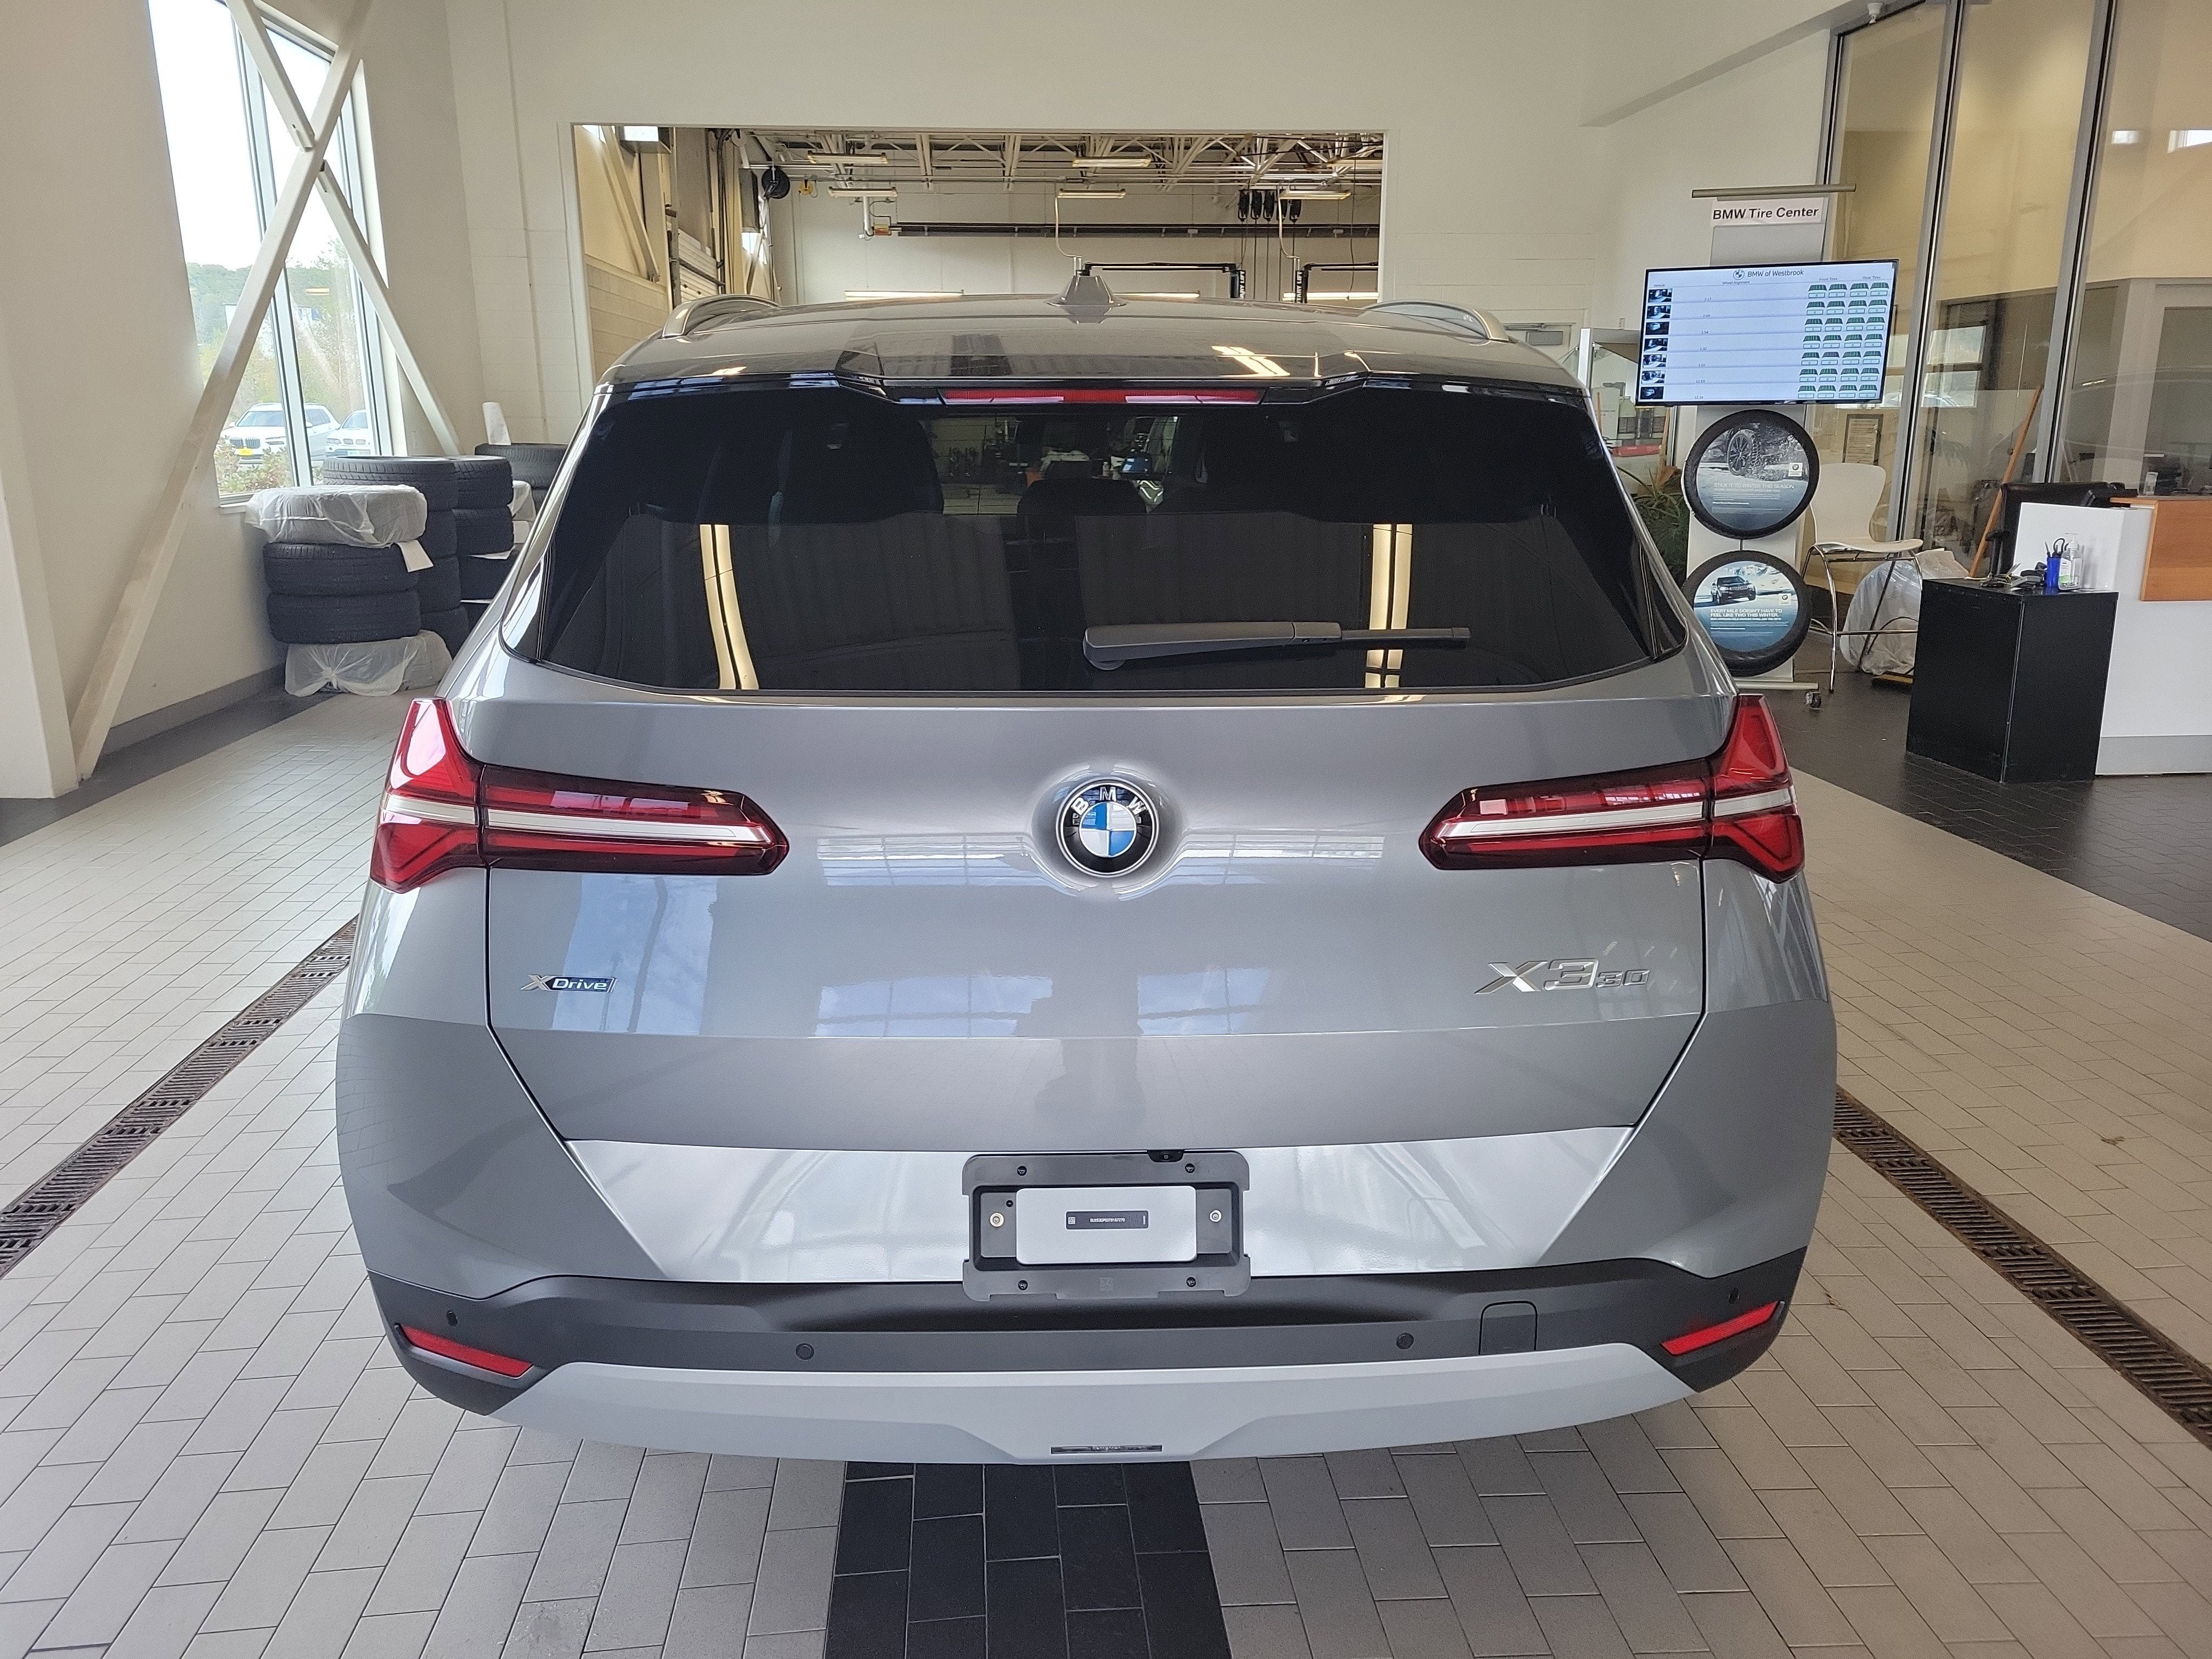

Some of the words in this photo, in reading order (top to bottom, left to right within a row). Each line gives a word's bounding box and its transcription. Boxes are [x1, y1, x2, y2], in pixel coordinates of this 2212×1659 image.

[1713, 208, 1746, 219] BMW
[1749, 208, 1773, 218] Tire
[1776, 207, 1819, 218] Center
[1071, 786, 1146, 816] BMW
[1474, 958, 1599, 994] X3
